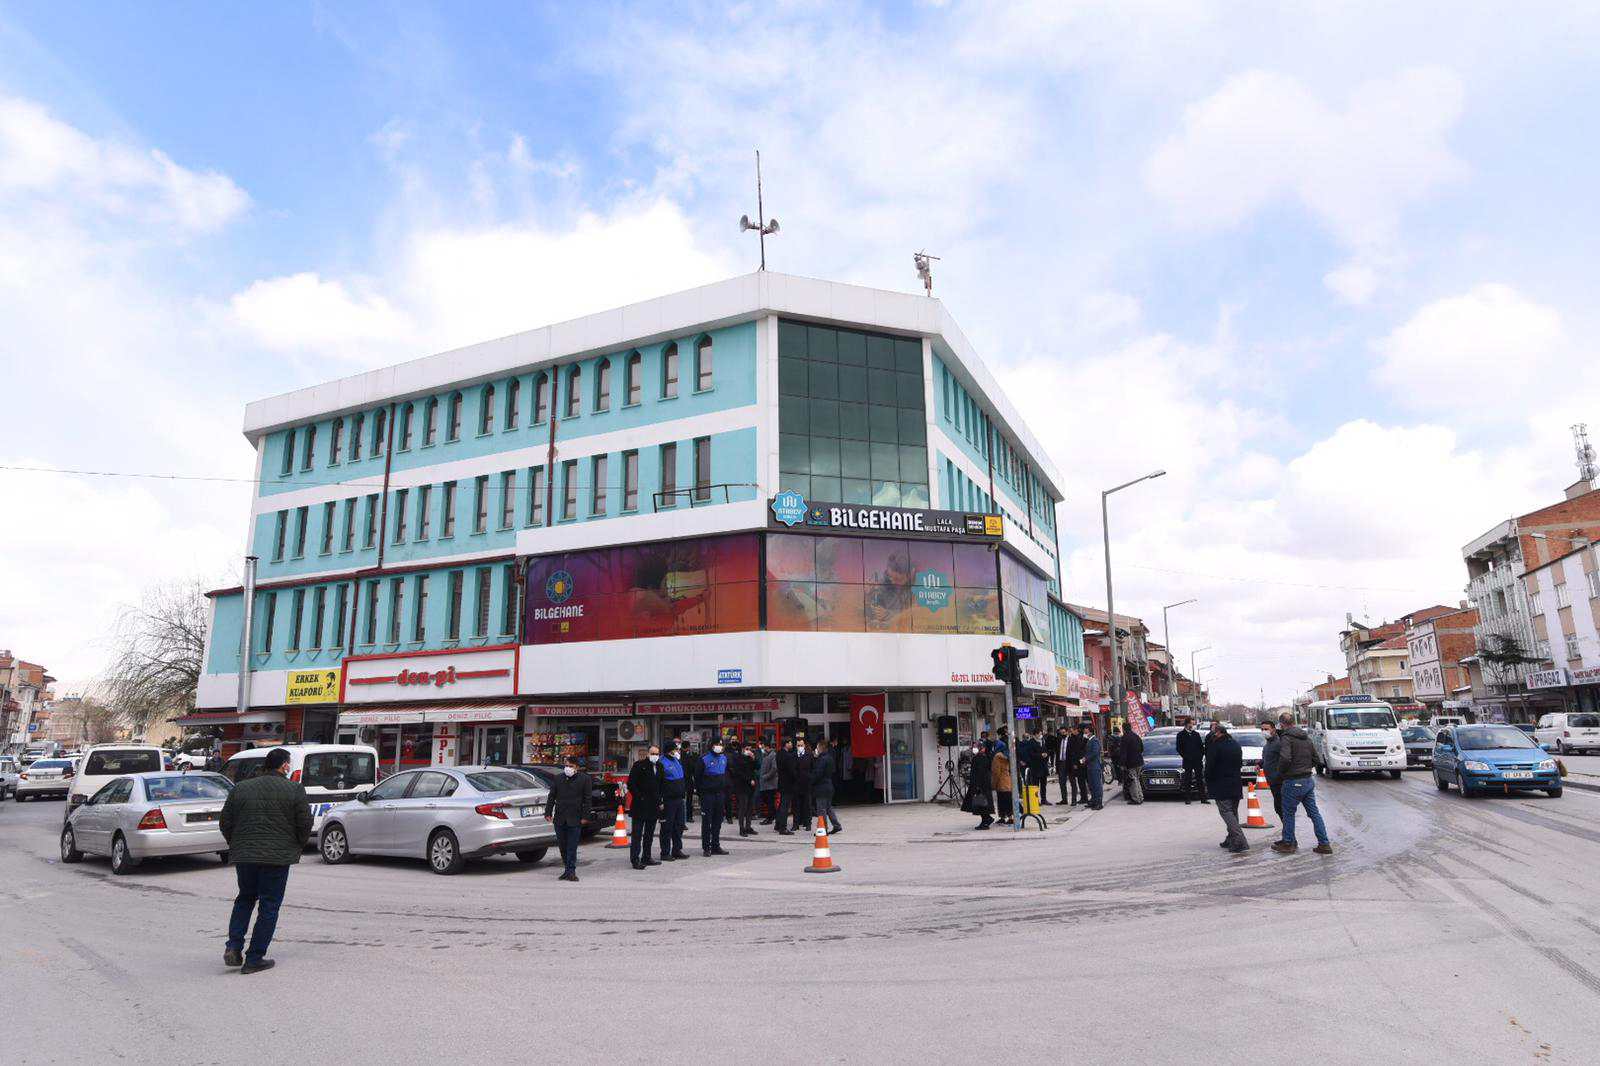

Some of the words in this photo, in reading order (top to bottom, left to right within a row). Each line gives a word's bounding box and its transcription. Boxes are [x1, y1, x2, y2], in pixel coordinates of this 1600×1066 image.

[924, 525, 951, 533] MUSTAFA
[951, 526, 966, 535] PAŞA
[295, 674, 320, 684] ERKEK
[597, 706, 632, 714] MARKET
[717, 703, 757, 712] MARKET
